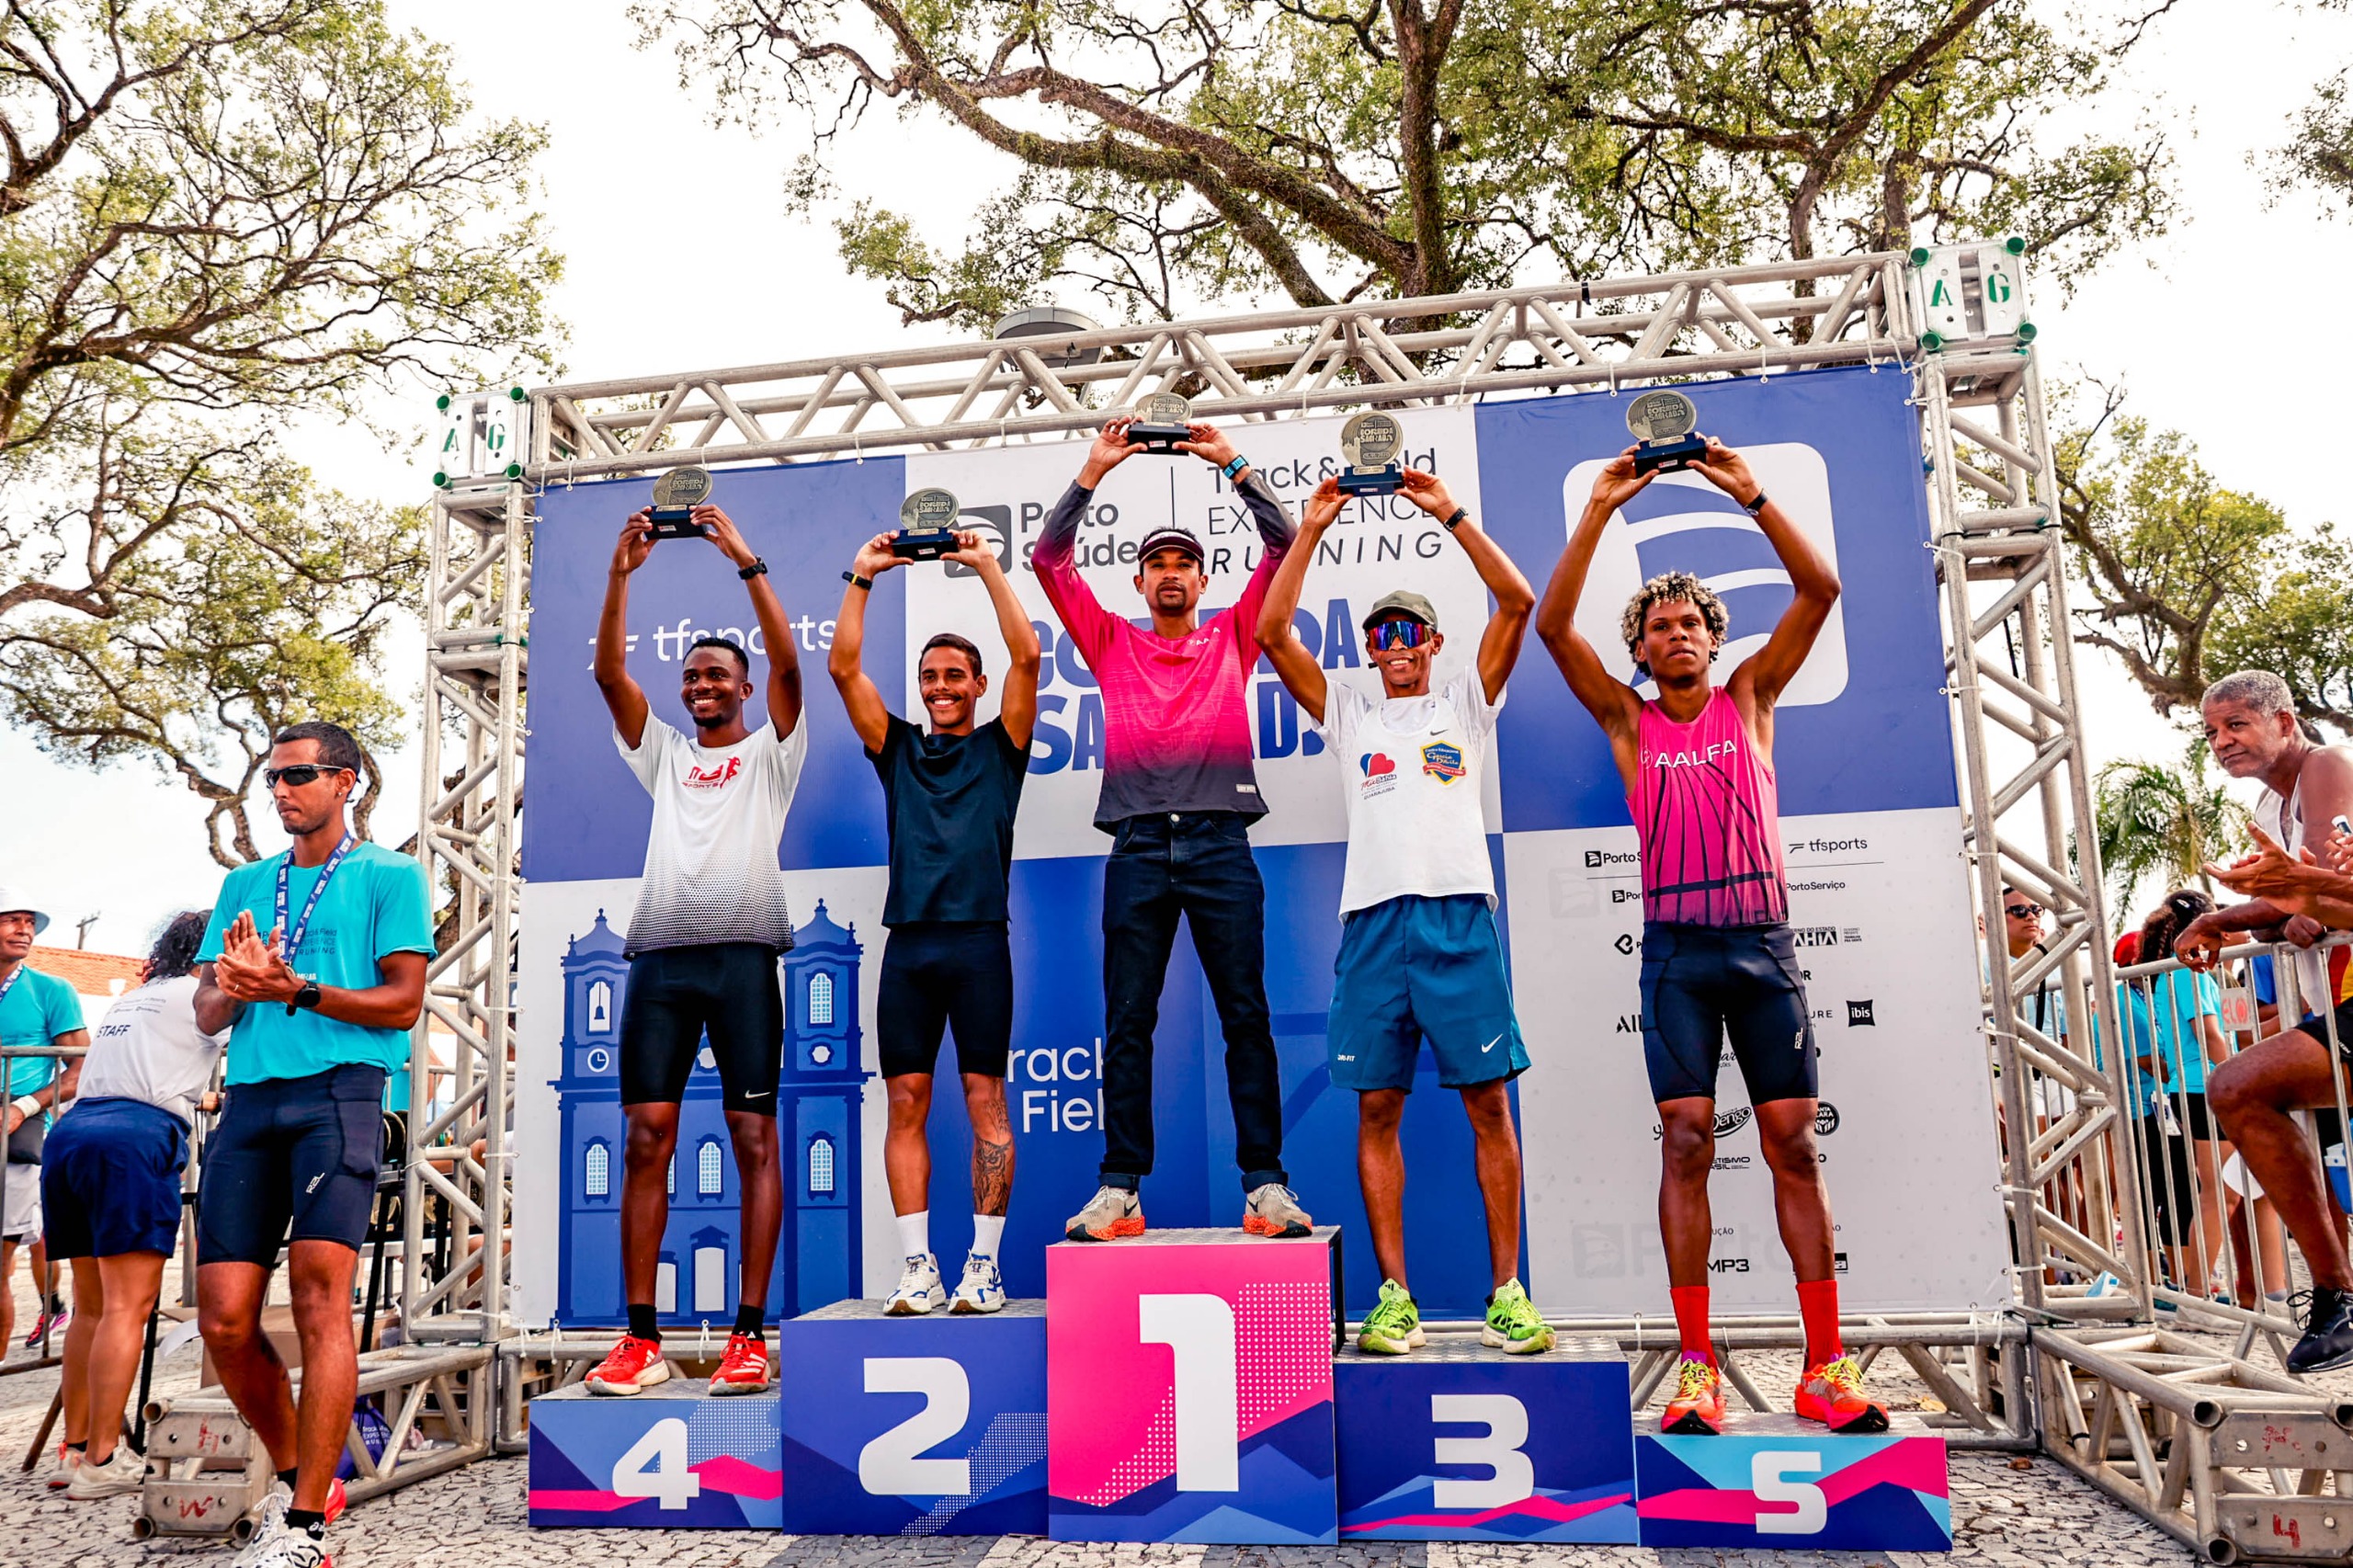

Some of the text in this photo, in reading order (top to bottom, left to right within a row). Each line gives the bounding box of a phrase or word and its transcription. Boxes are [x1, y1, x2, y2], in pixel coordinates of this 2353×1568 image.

[1654, 739, 1737, 768] AALFA
[1809, 838, 1869, 853] tfsports
[1792, 931, 1837, 948] AHIA
[97, 1025, 131, 1038] STAFF
[1850, 1007, 1870, 1017] ibis
[1022, 1088, 1105, 1133] Fiel
[1139, 1293, 1239, 1492] 1
[858, 1358, 971, 1495] 2
[612, 1417, 699, 1510] 4
[1430, 1394, 1534, 1508] 3
[1751, 1450, 1828, 1535] 5
